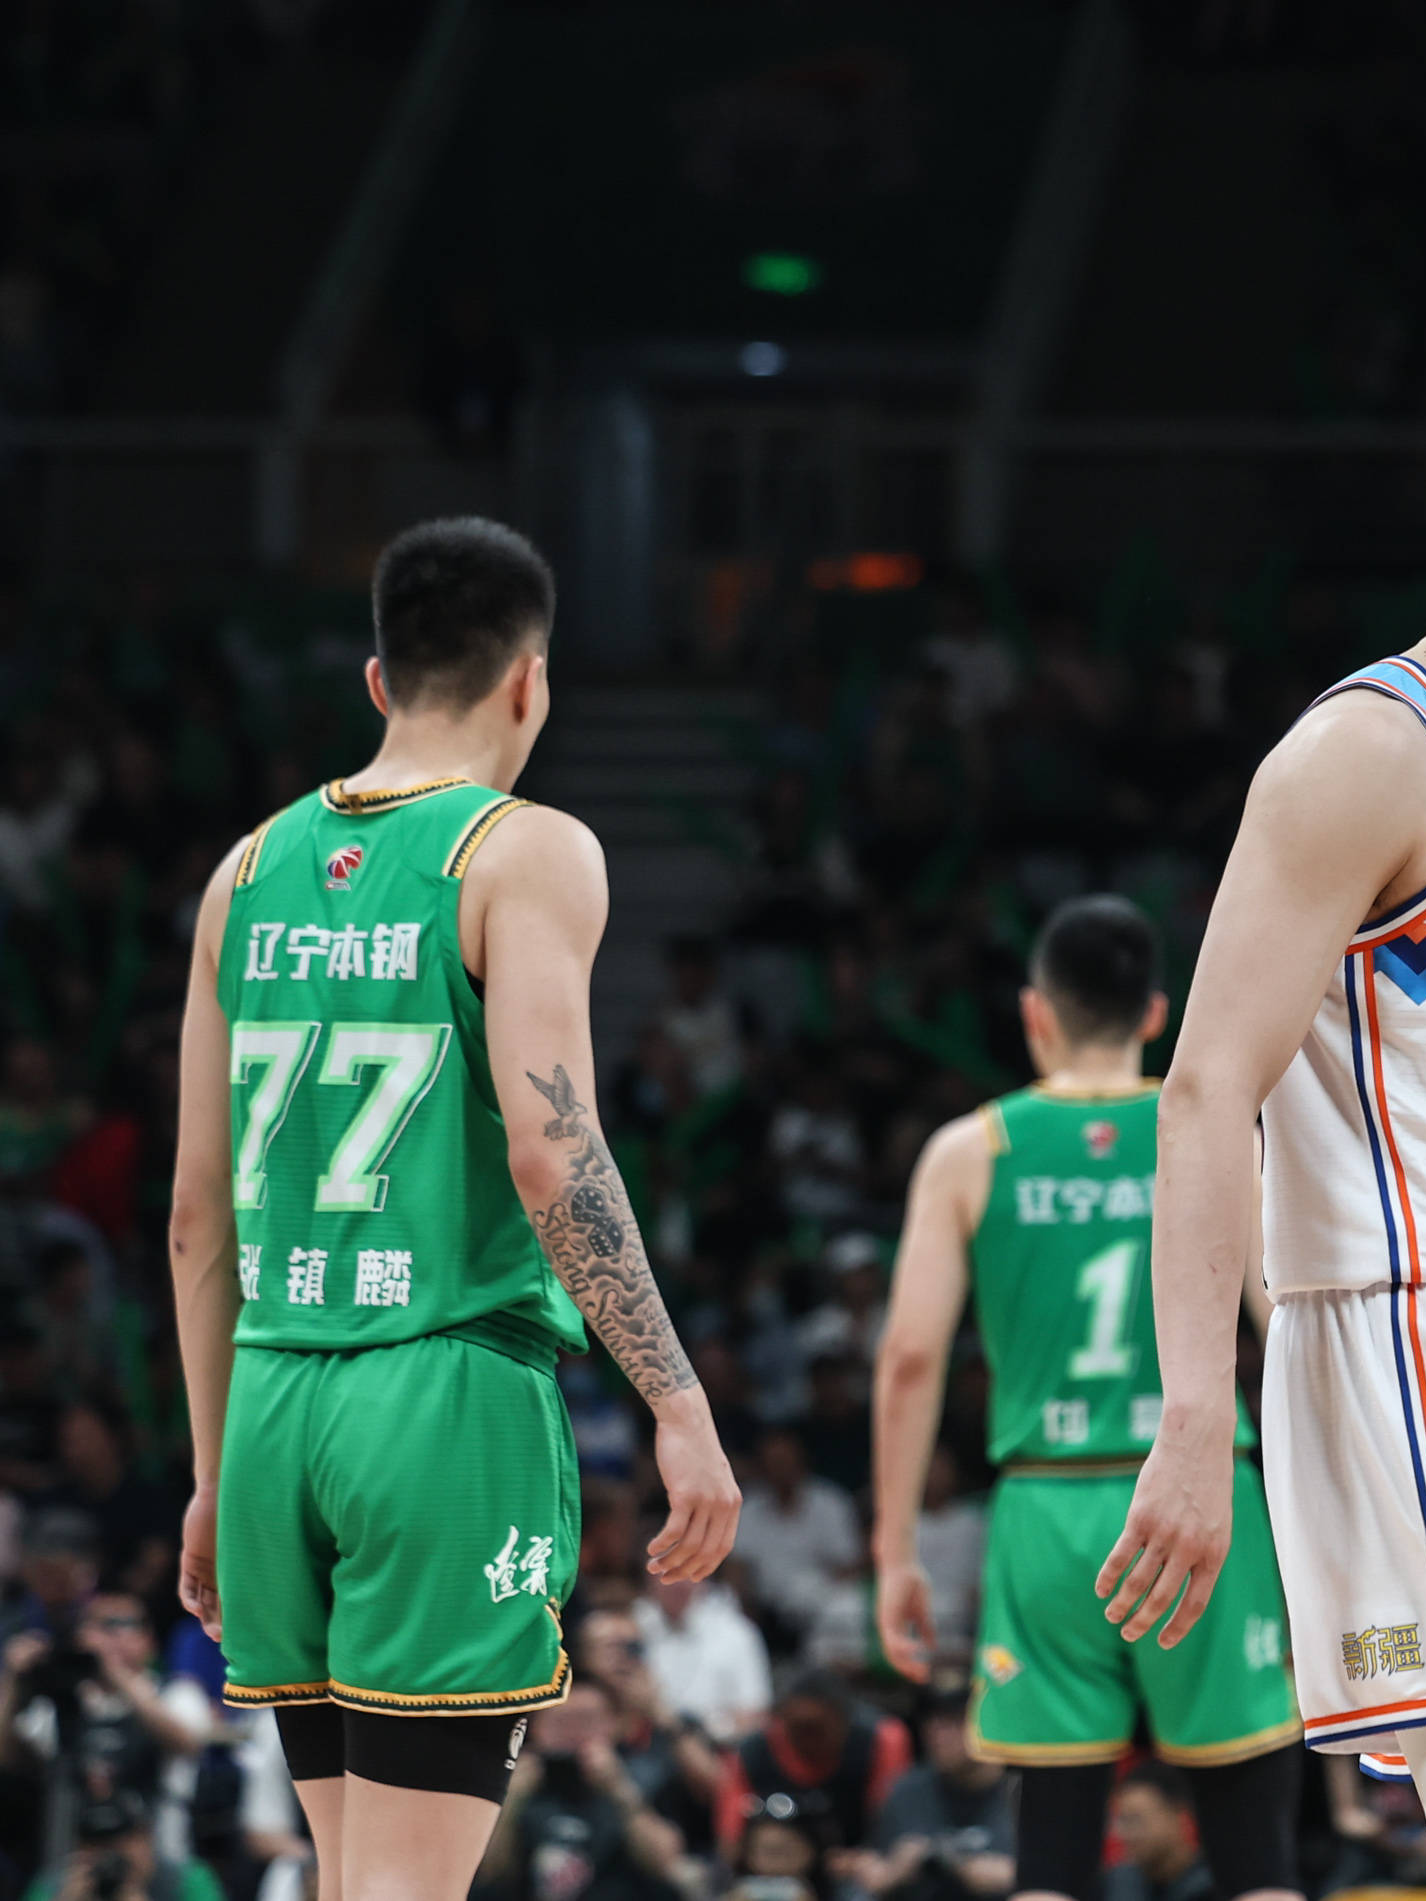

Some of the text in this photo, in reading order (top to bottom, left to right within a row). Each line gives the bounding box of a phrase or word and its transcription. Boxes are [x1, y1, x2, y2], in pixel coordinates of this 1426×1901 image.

[244, 922, 421, 981] 辽宁本钢
[230, 1020, 453, 1212] 77
[1015, 1175, 1155, 1225] 辽宁本
[535, 1202, 592, 1296] Strong
[1068, 1238, 1148, 1380] 1
[1341, 1623, 1424, 1680] 新疆
